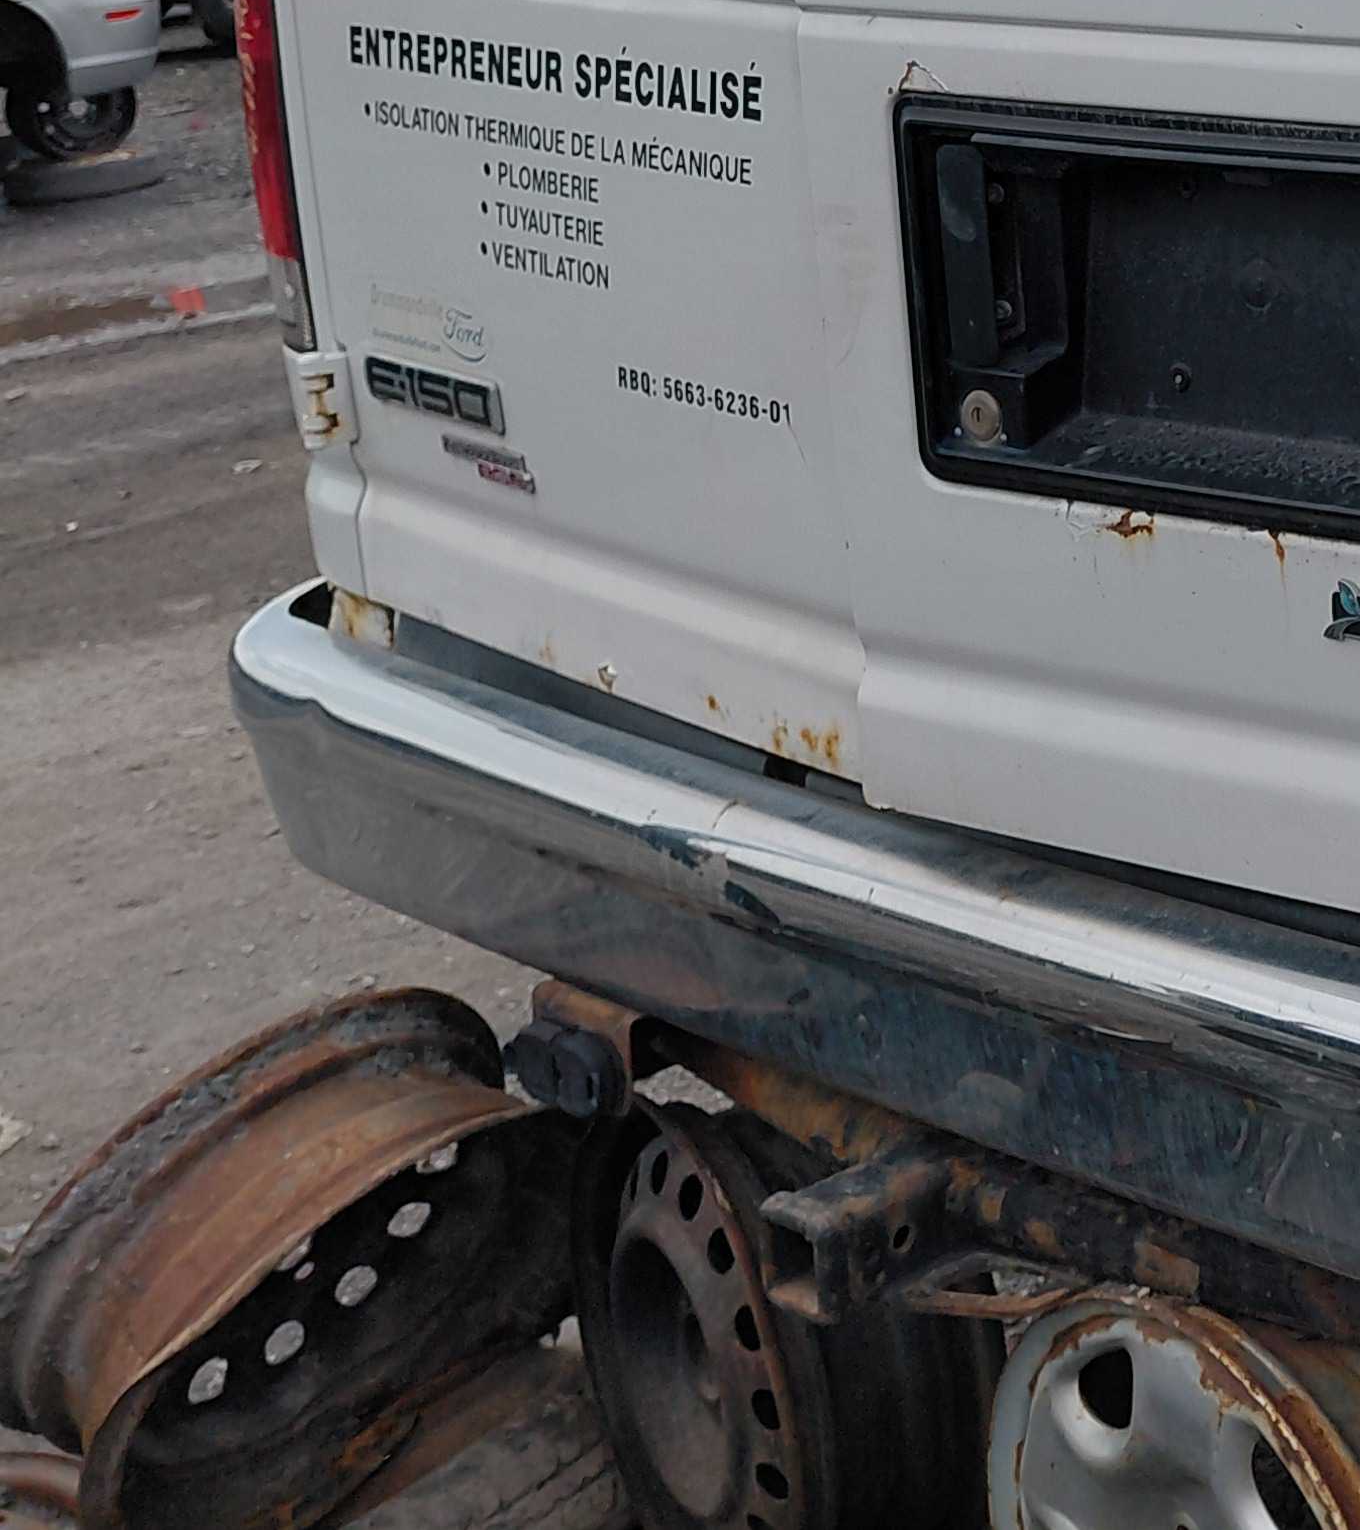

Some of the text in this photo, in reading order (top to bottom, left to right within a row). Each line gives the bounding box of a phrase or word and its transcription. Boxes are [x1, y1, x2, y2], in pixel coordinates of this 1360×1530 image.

[350, 26, 763, 121] ENTREPRENEUR SPÉCIALISÉ
[375, 101, 752, 185] ISOLATION THERMIQUE DE LA MÉCANIQUE
[498, 162, 599, 203] PLOMBERIE
[495, 202, 604, 246] TUYAUTERIE
[492, 242, 610, 289] VENTILATION
[618, 367, 791, 424] RBQ: 5663-6236-01
